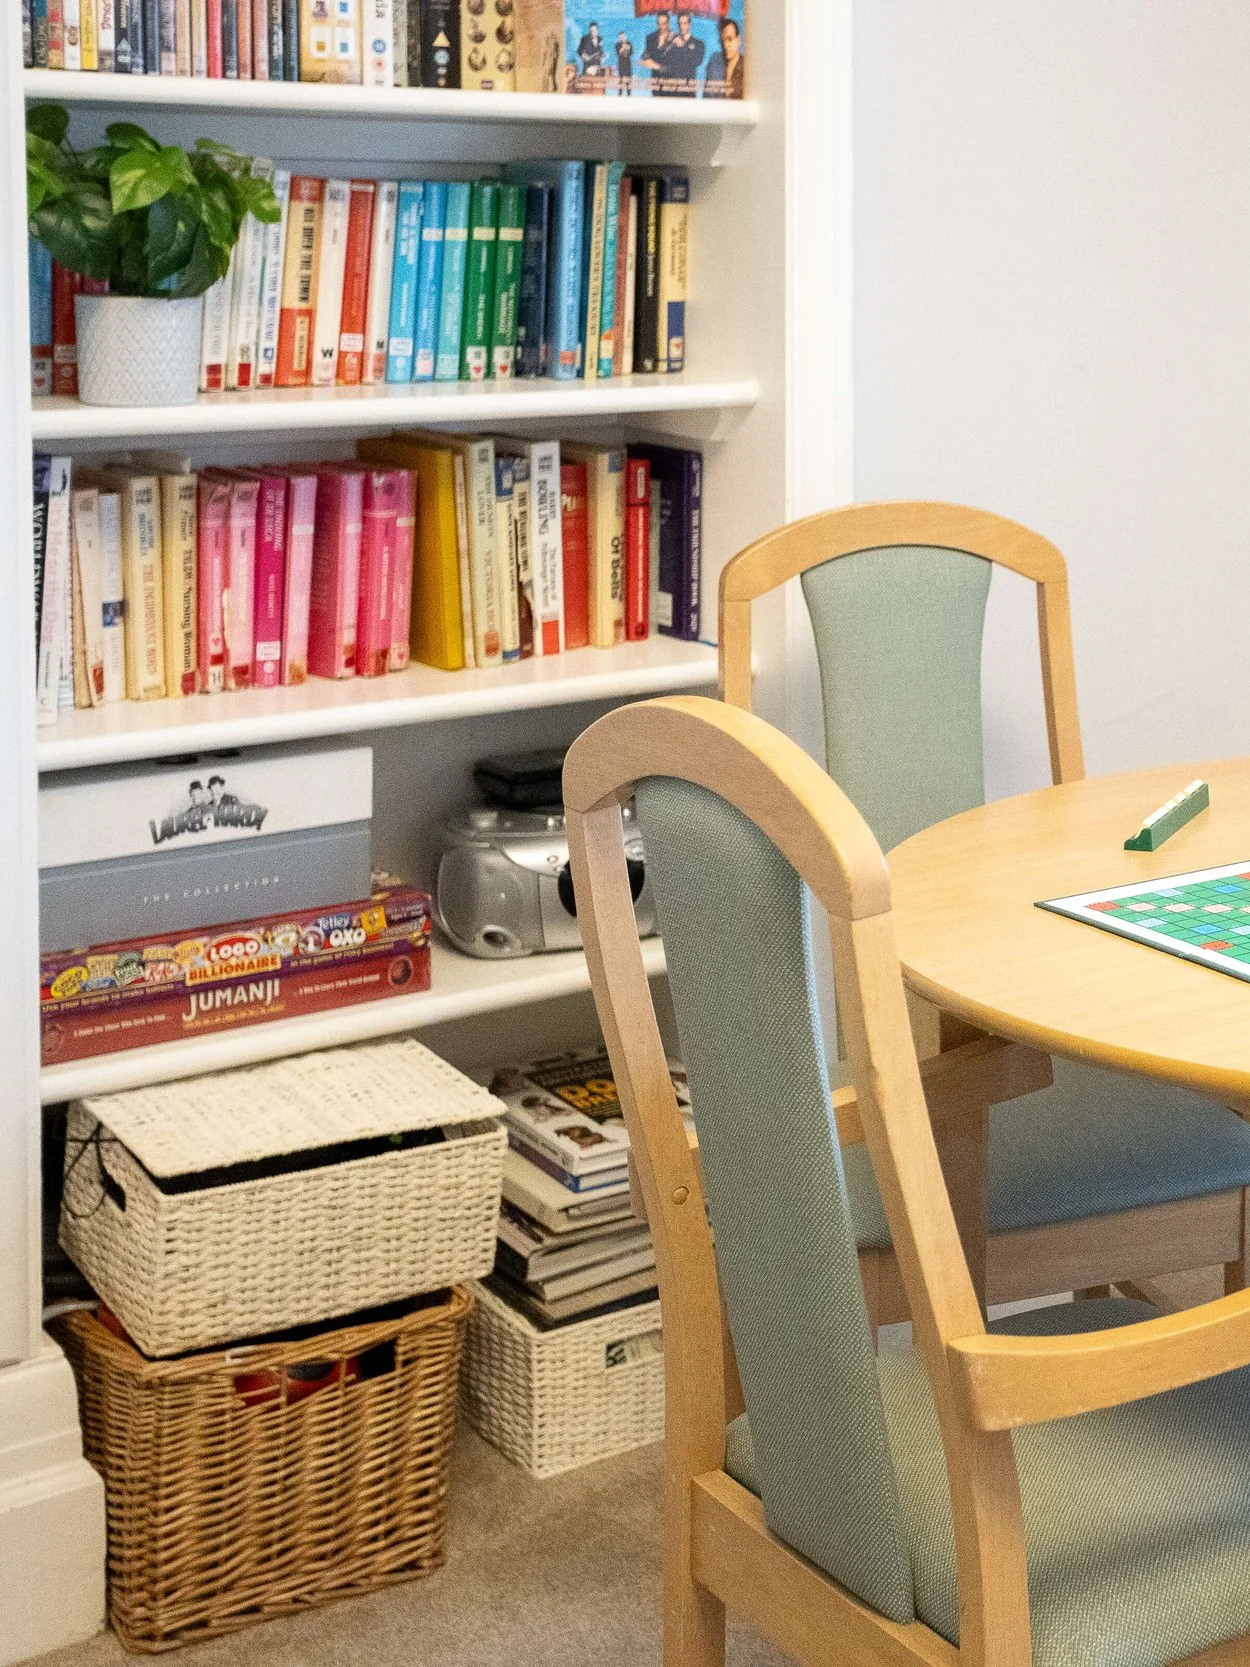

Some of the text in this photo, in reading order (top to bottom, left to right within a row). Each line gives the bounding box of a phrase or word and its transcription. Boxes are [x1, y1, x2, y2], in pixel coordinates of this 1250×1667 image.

[183, 875, 279, 899] COLLECTION
[317, 917, 350, 930] Tetley
[329, 928, 367, 947] OXO
[209, 939, 260, 962] LOGO
[189, 956, 278, 981] BILLIONAIRE
[182, 979, 280, 1021] JUMANJI
